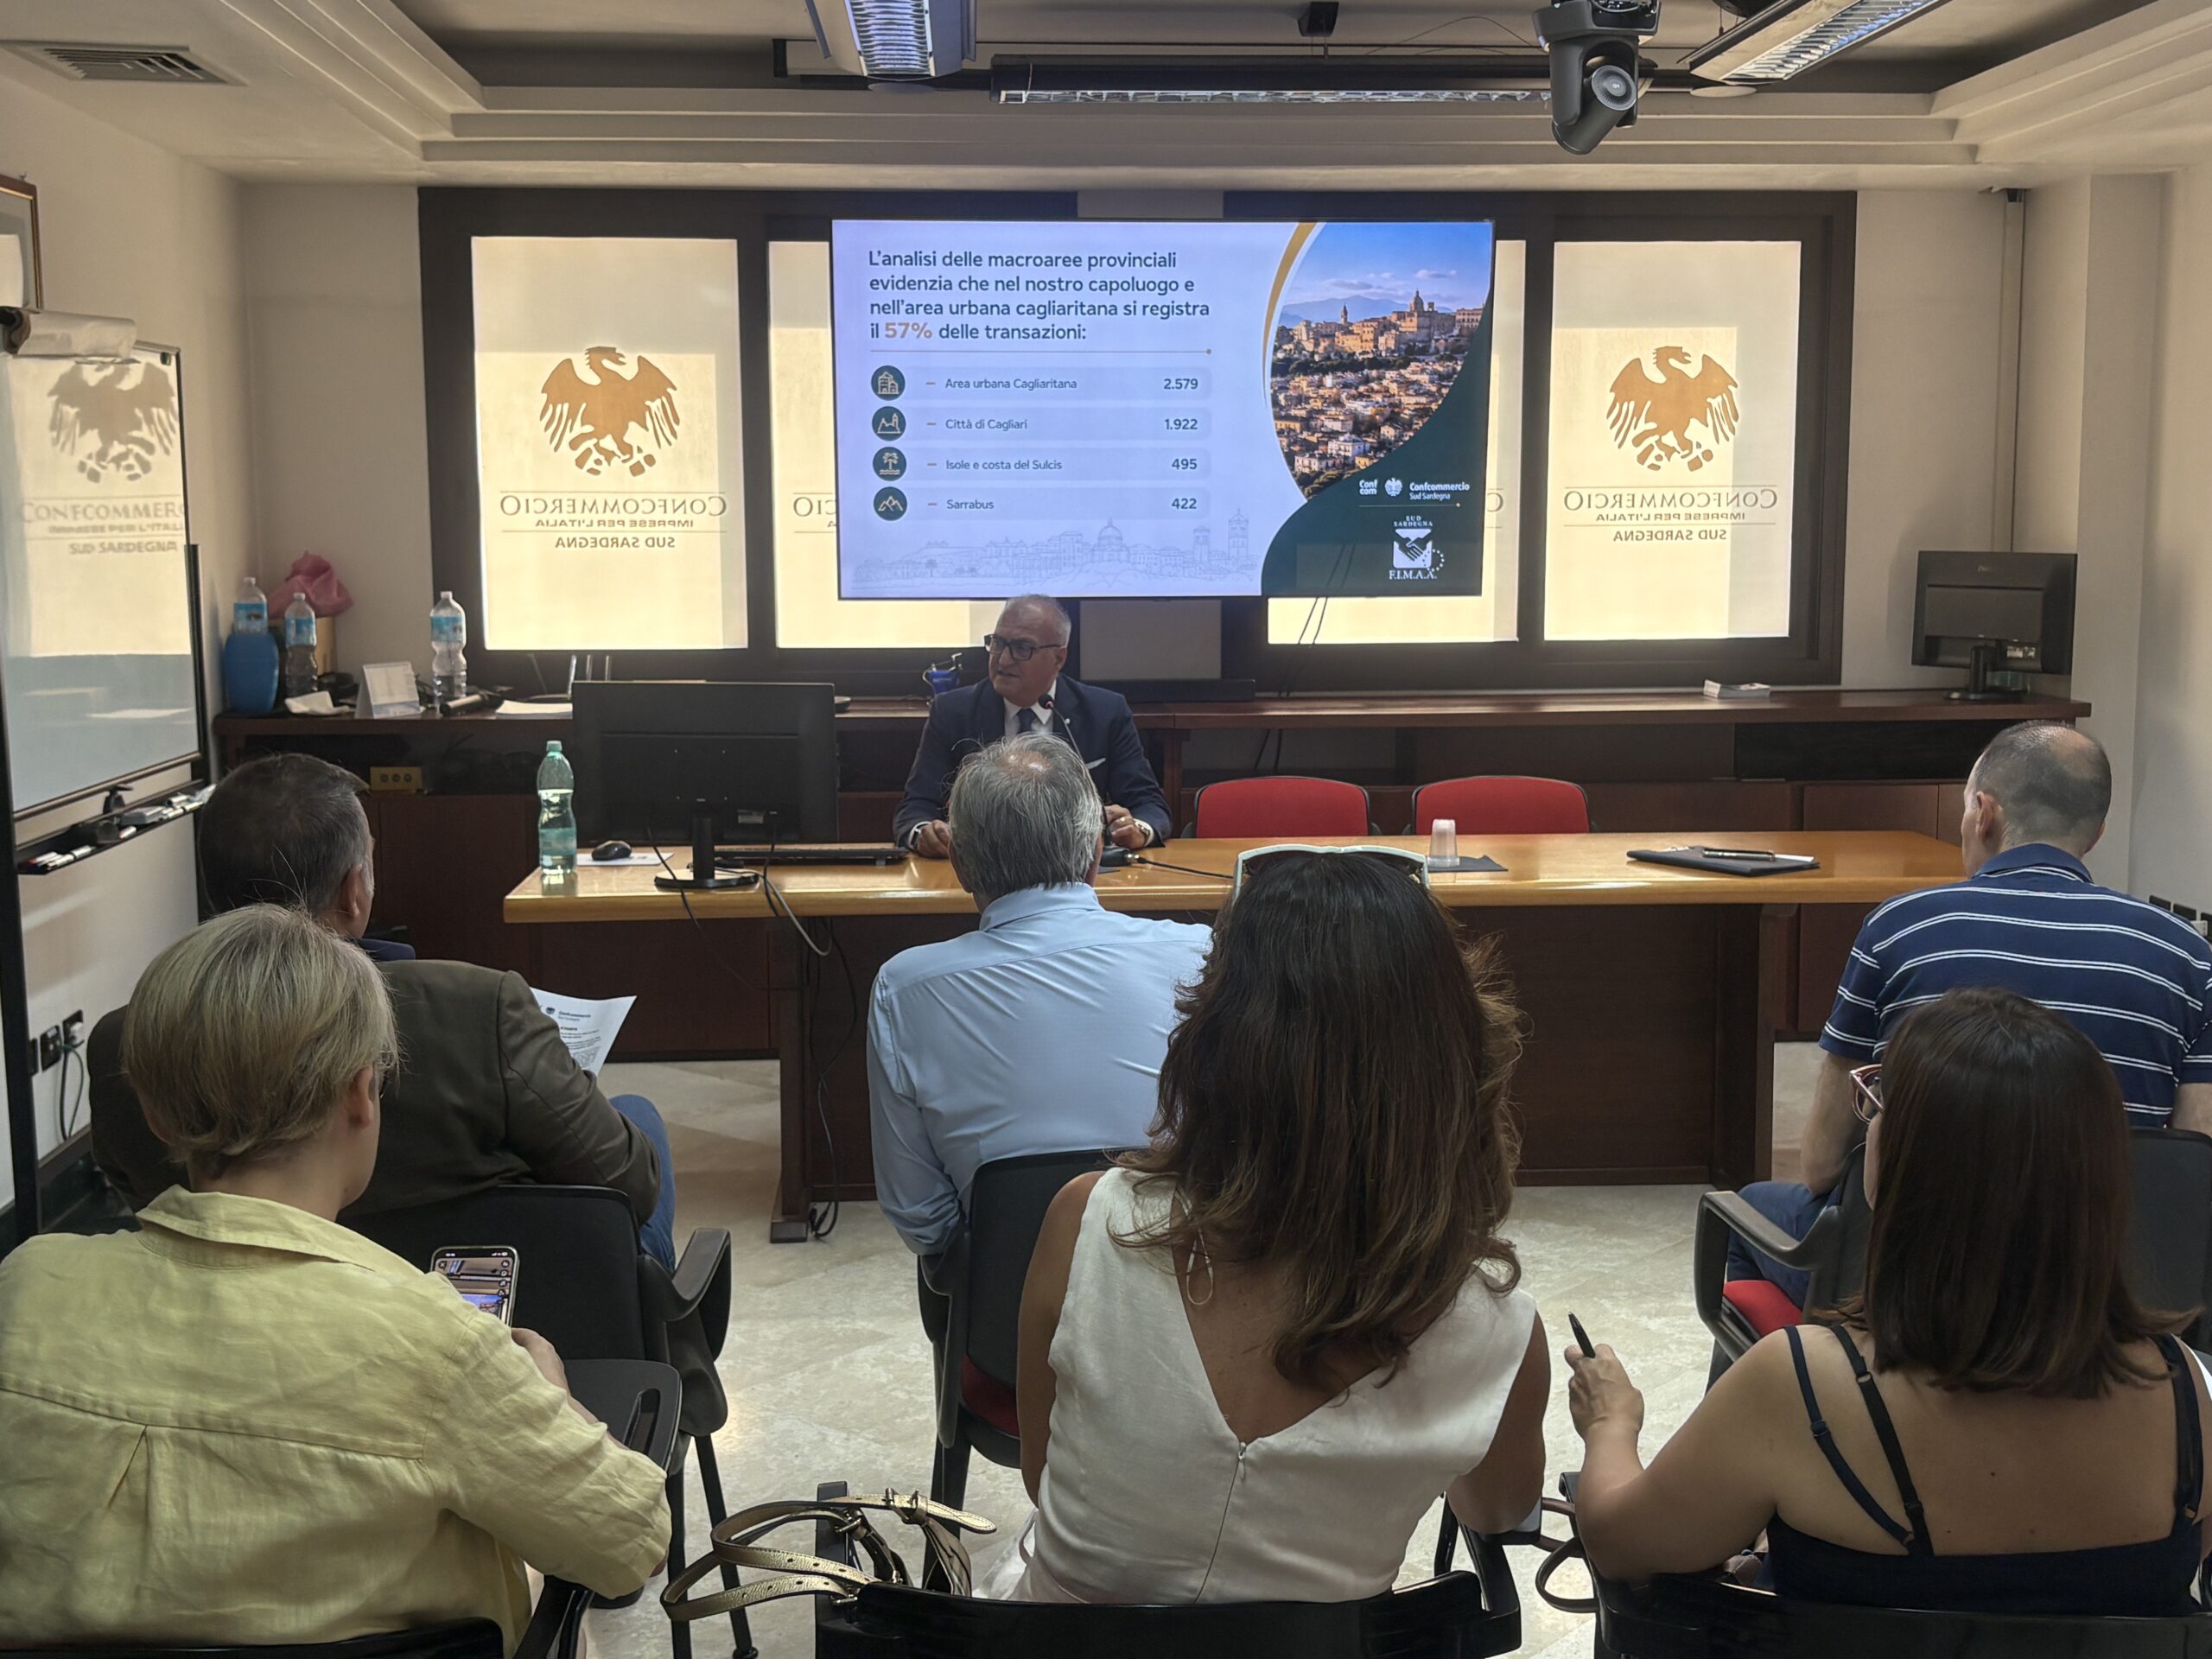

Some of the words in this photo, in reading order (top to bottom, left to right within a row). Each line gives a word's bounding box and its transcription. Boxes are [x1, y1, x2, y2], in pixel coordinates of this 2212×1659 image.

[869, 251, 936, 266] L'analisi
[943, 251, 982, 266] delle
[988, 256, 1082, 267] macroaree
[1088, 252, 1176, 271] provinciali
[870, 275, 952, 290] evidenzia
[958, 276, 988, 290] che
[995, 276, 1020, 291] nel
[1026, 277, 1083, 291] nostro
[1089, 276, 1179, 296] capoluogo
[1185, 281, 1194, 291] e
[871, 300, 943, 315] nell'area
[950, 300, 1010, 315] urbana
[1016, 301, 1117, 320] cagliaritana
[1123, 301, 1136, 315] si
[1142, 301, 1209, 320] registra
[871, 323, 879, 338] il
[885, 322, 932, 339] 57%
[939, 324, 979, 339] delle
[985, 324, 1085, 339] transazioni:
[945, 378, 970, 388] Area
[973, 379, 1010, 388] urbana
[1014, 379, 1077, 391] Cagliaritana
[1164, 378, 1198, 390] 2.579
[946, 419, 972, 429] Città
[975, 419, 985, 429] di
[988, 420, 1027, 431] Cagliari
[1165, 419, 1198, 429] 1.922
[946, 461, 969, 469] Isole
[1014, 461, 1029, 469] del
[1033, 461, 1062, 470] Sulcis
[1172, 459, 1197, 469] 495
[1359, 480, 1377, 488] Conf
[1409, 482, 1470, 491] Confcommercio
[1422, 493, 1450, 501] Sardegna
[947, 499, 994, 509] Sarrabus
[1172, 499, 1196, 509] 422
